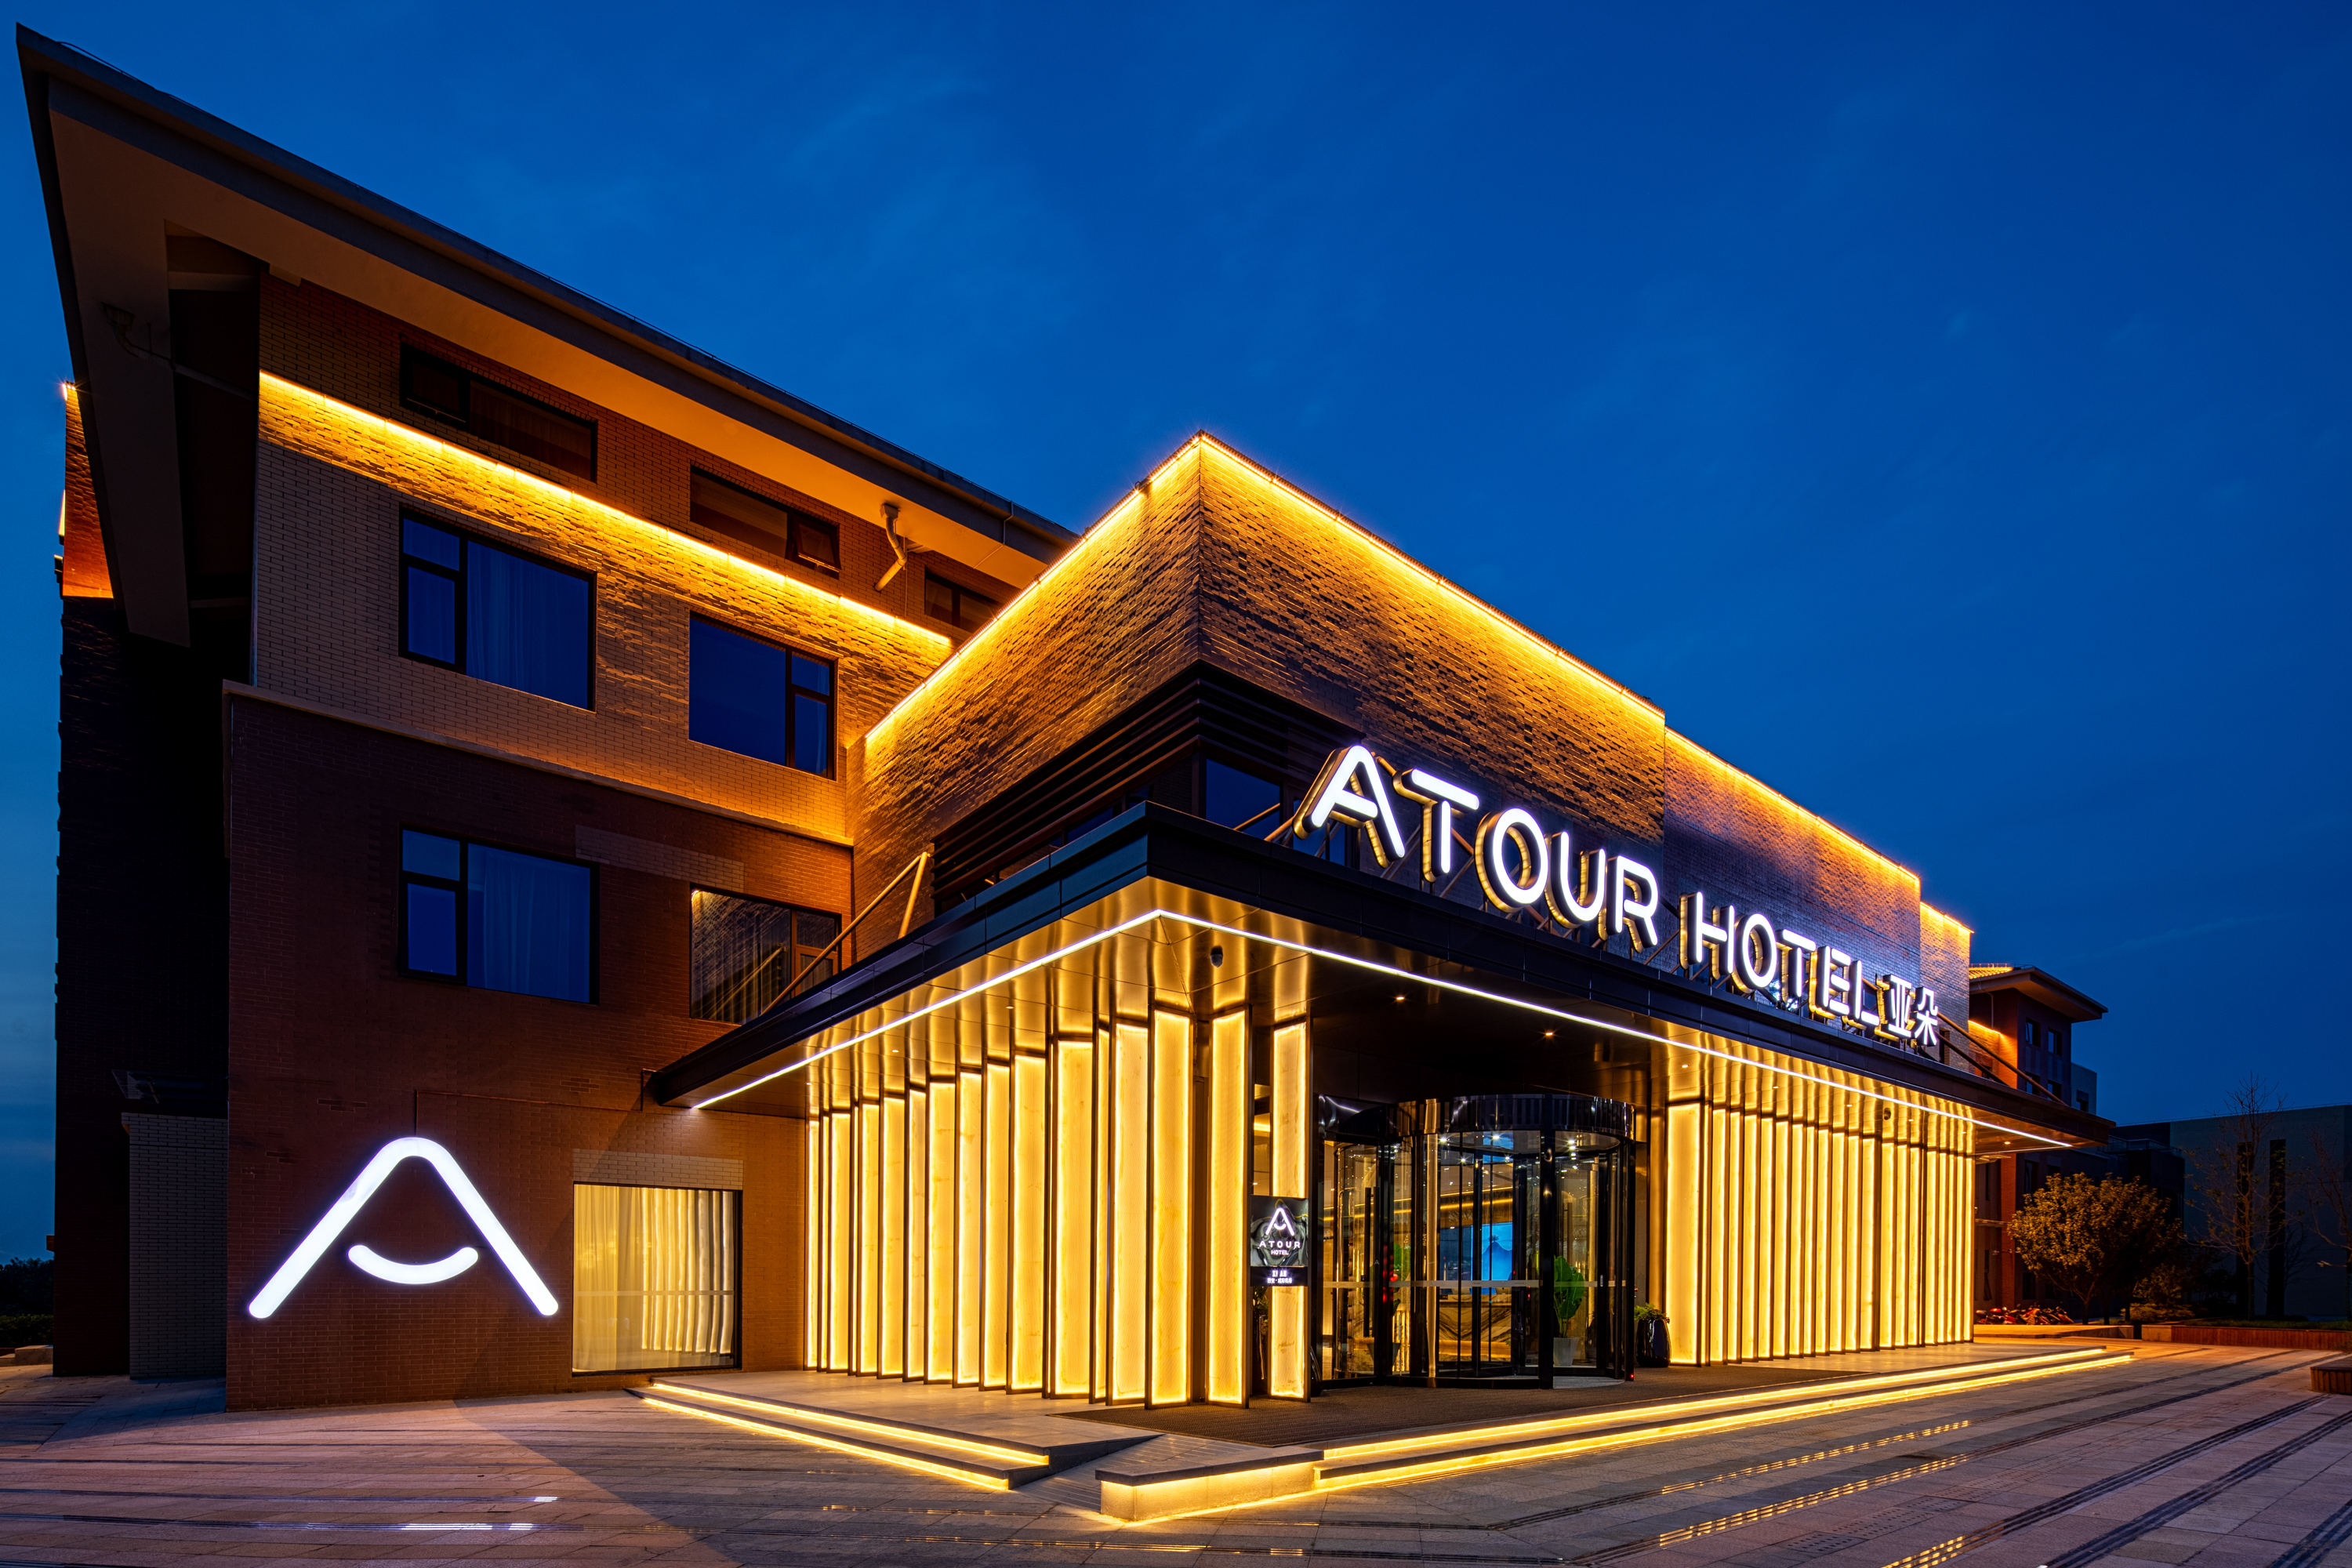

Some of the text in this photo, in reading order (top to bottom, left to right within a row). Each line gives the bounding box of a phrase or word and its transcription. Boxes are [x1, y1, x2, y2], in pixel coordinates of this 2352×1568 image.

[1308, 745, 1939, 1047] ATOUR HOTEL 亚朵
[1258, 1240, 1301, 1249] ATOUR
